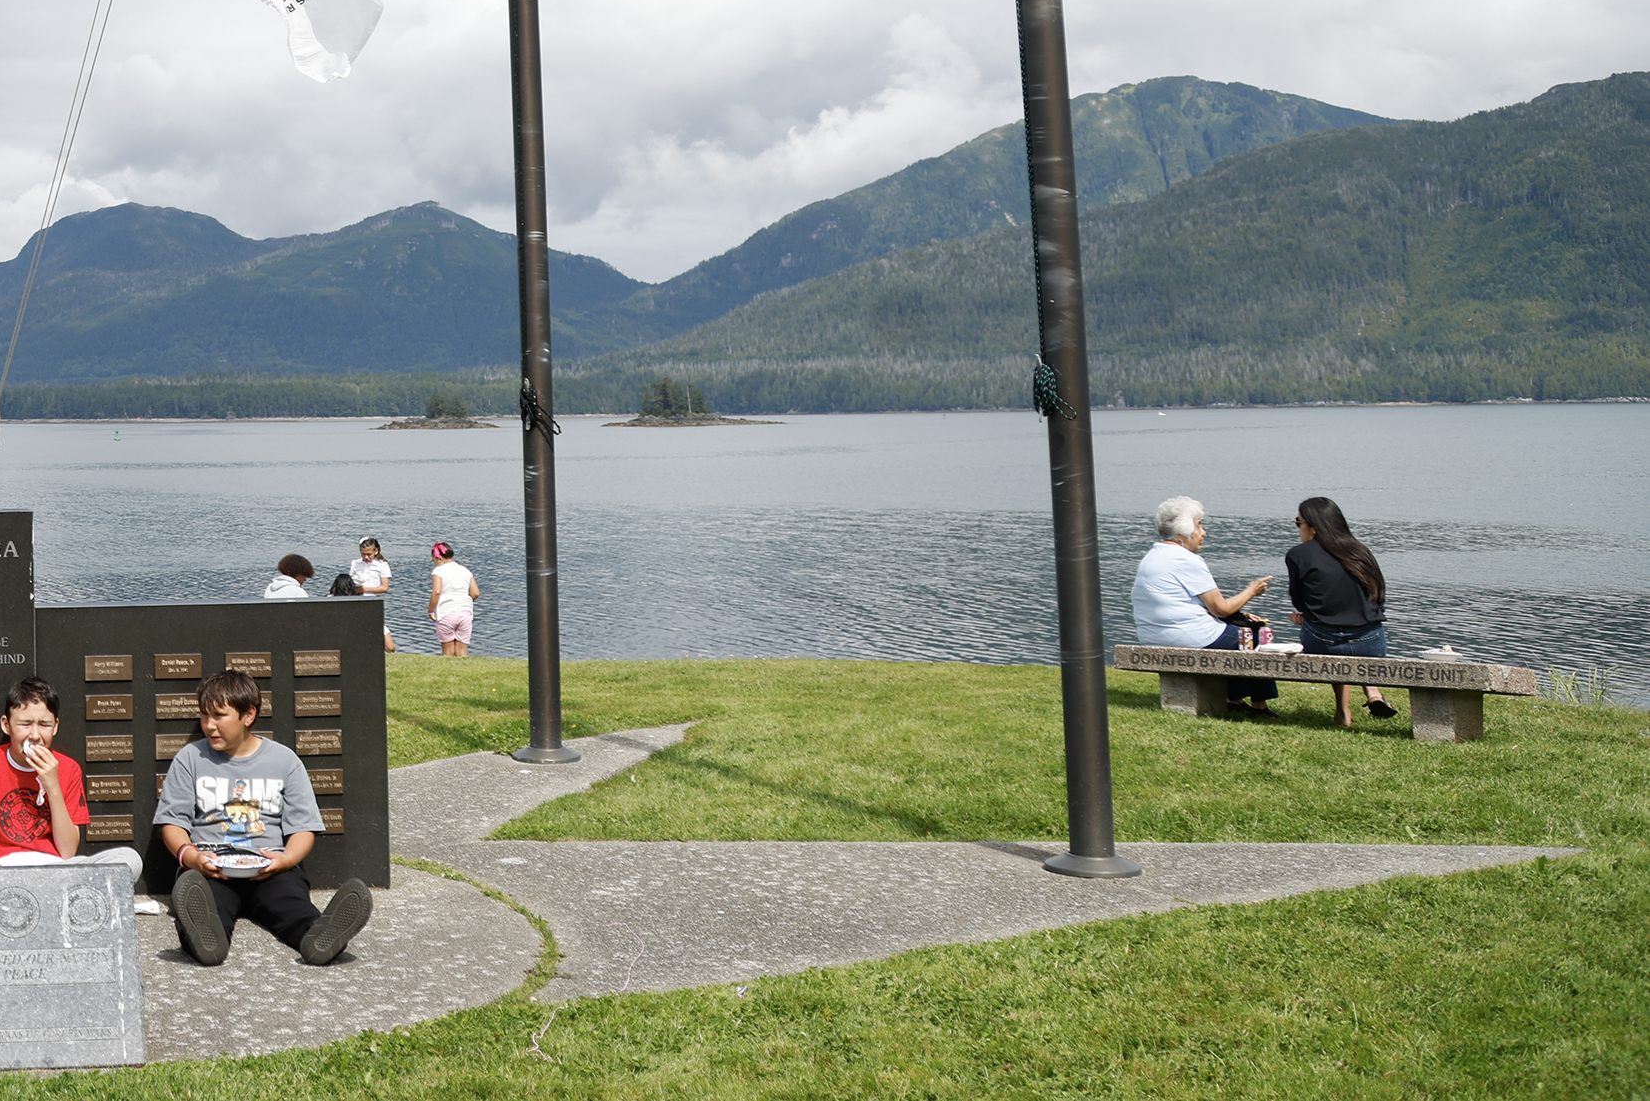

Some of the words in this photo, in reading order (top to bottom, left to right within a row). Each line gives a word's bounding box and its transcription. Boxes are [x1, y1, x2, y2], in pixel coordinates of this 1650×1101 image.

[1131, 653, 1196, 667] DONATED
[1200, 657, 1218, 668] BY
[1223, 657, 1291, 672] ANNETTE
[1295, 661, 1351, 675] ISLAND
[1357, 664, 1425, 680] SERVICE
[26, 953, 54, 965] OUR
[60, 952, 109, 964] NATION
[3, 968, 48, 980] PEACE
